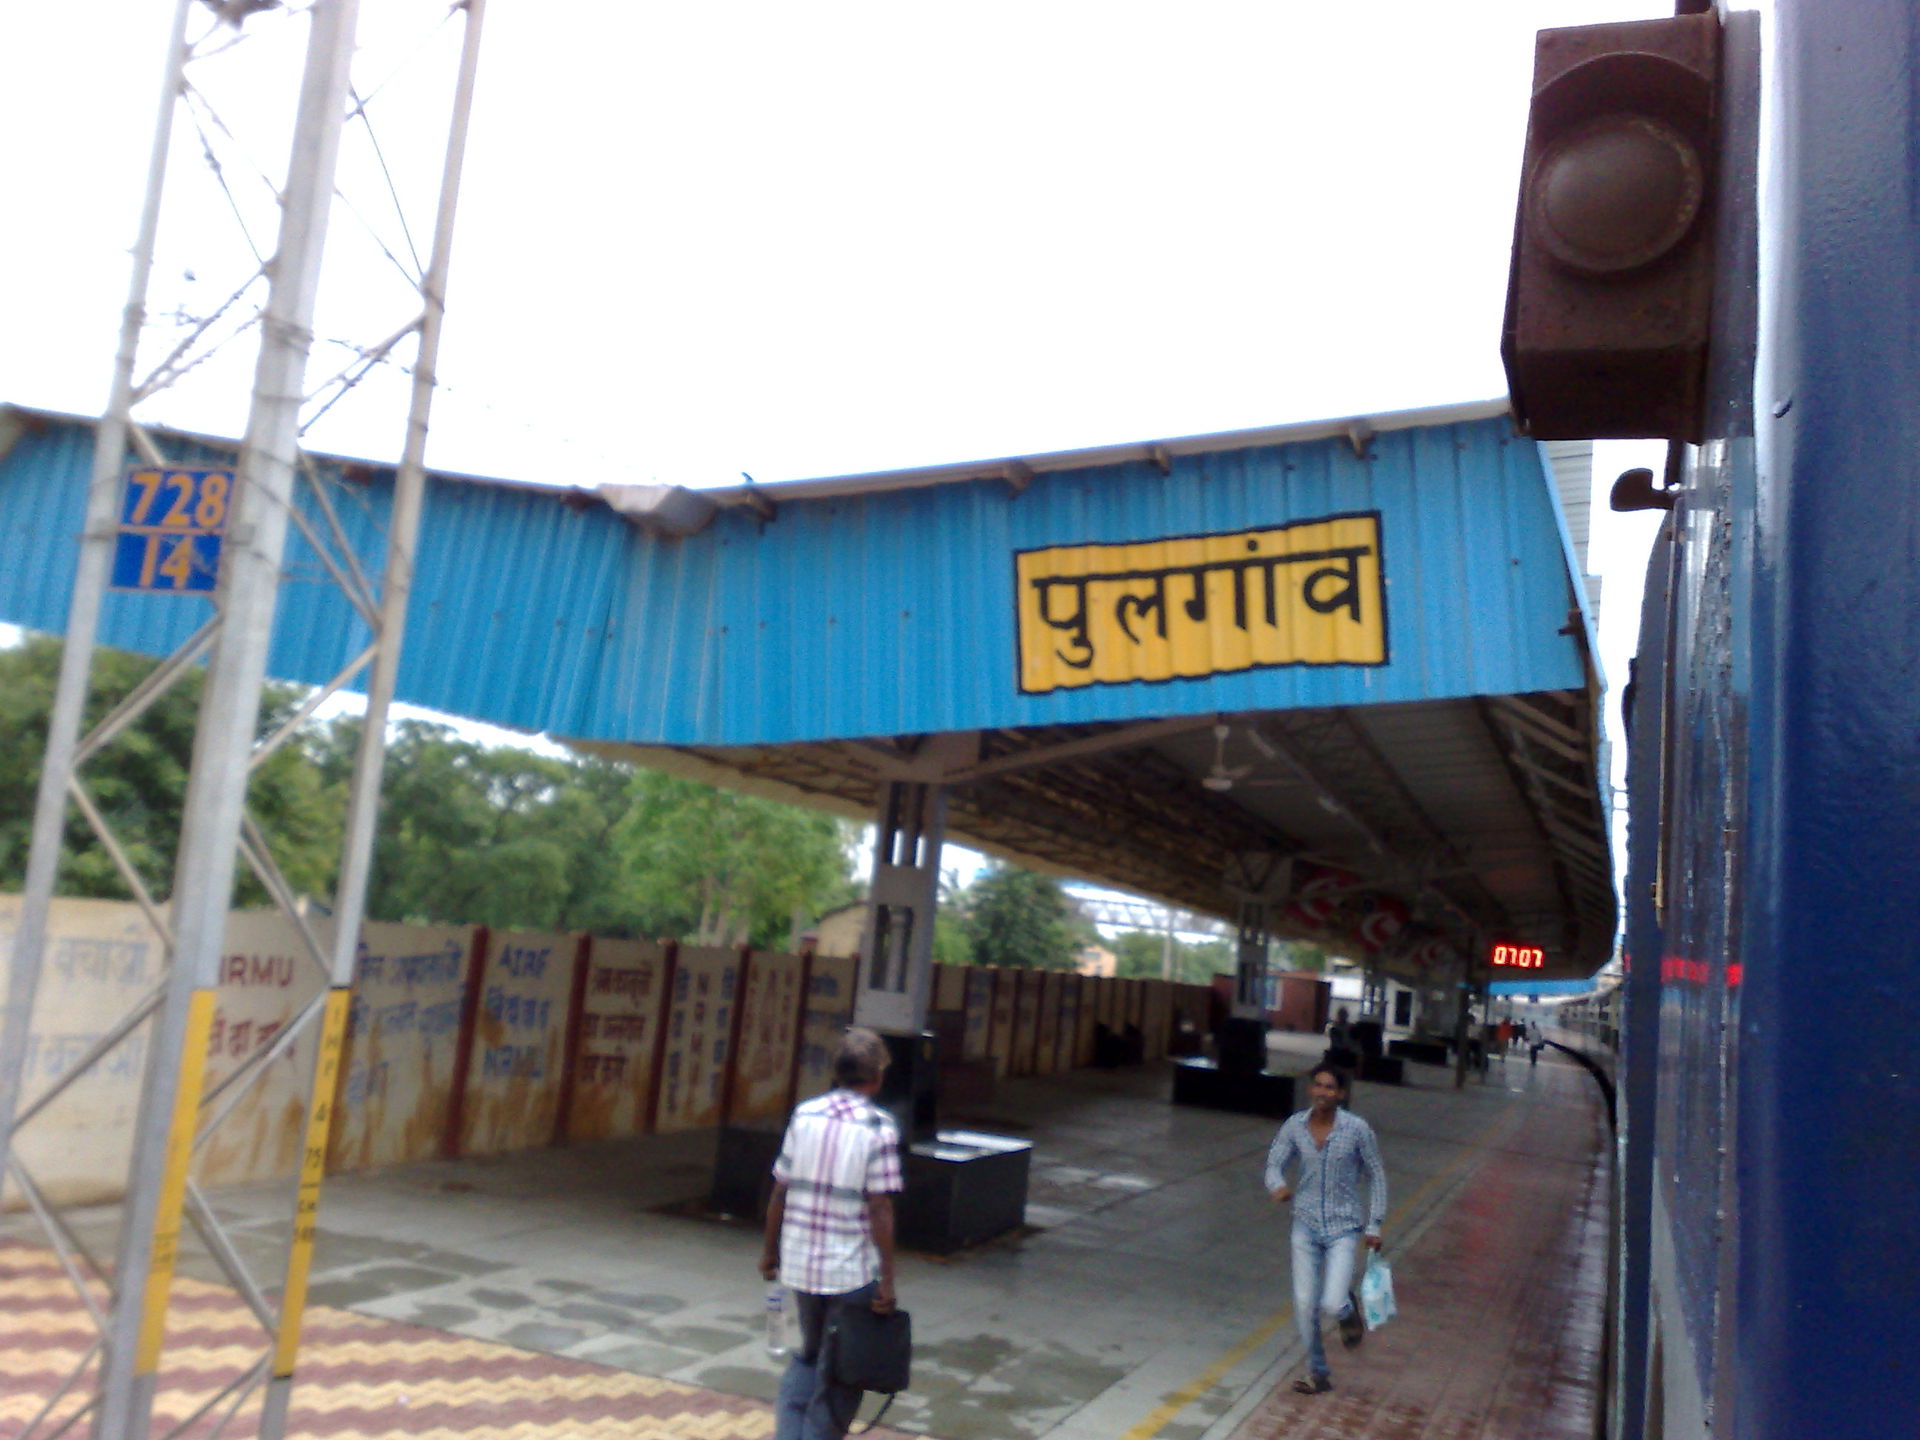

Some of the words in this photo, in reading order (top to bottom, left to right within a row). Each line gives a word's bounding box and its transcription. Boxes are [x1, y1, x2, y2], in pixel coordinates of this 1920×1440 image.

[131, 472, 228, 528] 728
[139, 534, 193, 589] 14
[1031, 539, 1371, 669] पुलगांव
[1493, 944, 1543, 968] 0707
